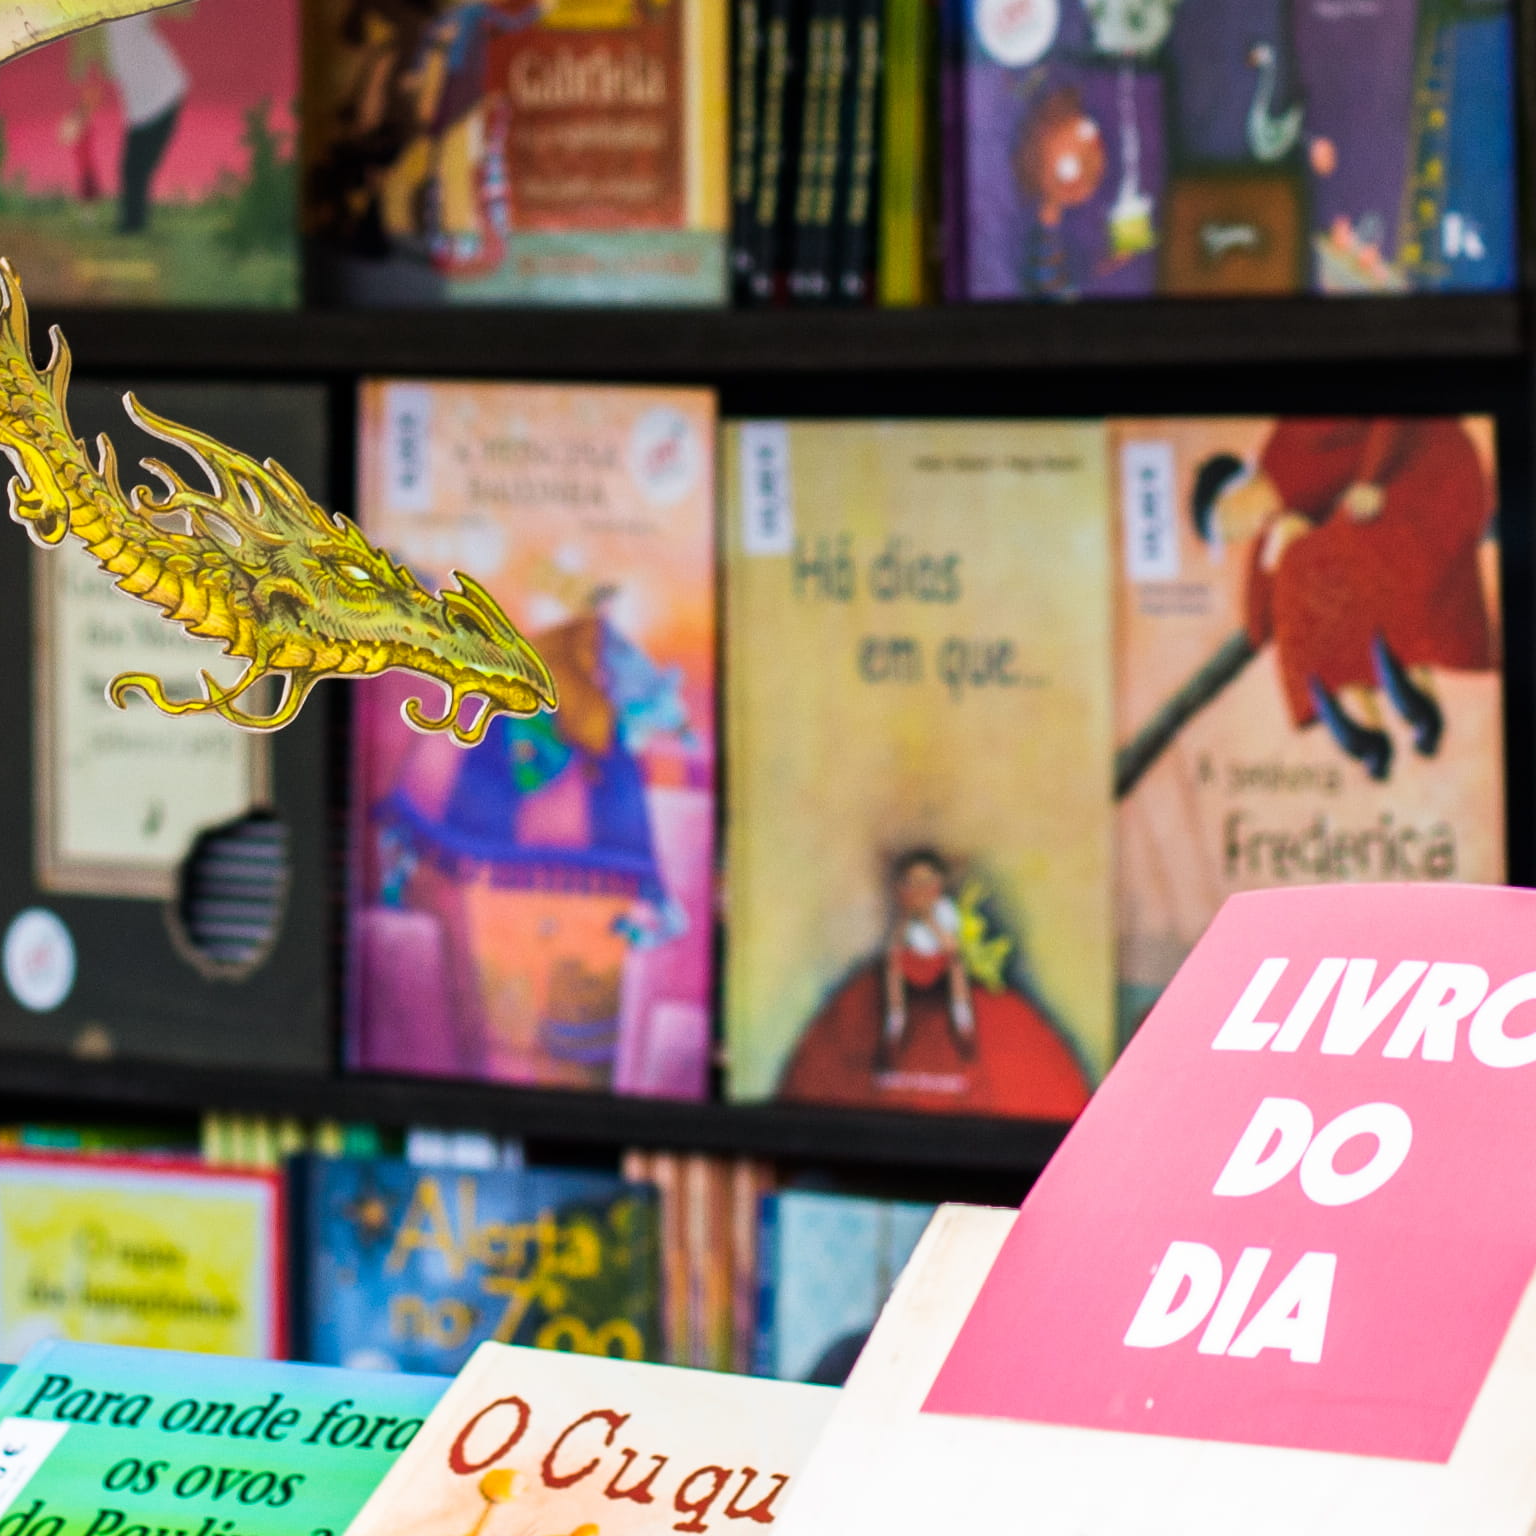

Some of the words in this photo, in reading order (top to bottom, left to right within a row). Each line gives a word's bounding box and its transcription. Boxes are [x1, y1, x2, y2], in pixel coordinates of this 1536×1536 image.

[1212, 1096, 1413, 1207] DO
[386, 1174, 602, 1279] Alerta
[391, 1294, 470, 1350] no
[1123, 1241, 1337, 1364] DIA
[17, 1372, 153, 1428] Para
[161, 1392, 302, 1443] onde
[448, 1395, 531, 1475] O
[101, 1456, 170, 1495] os
[173, 1464, 306, 1508] ovos
